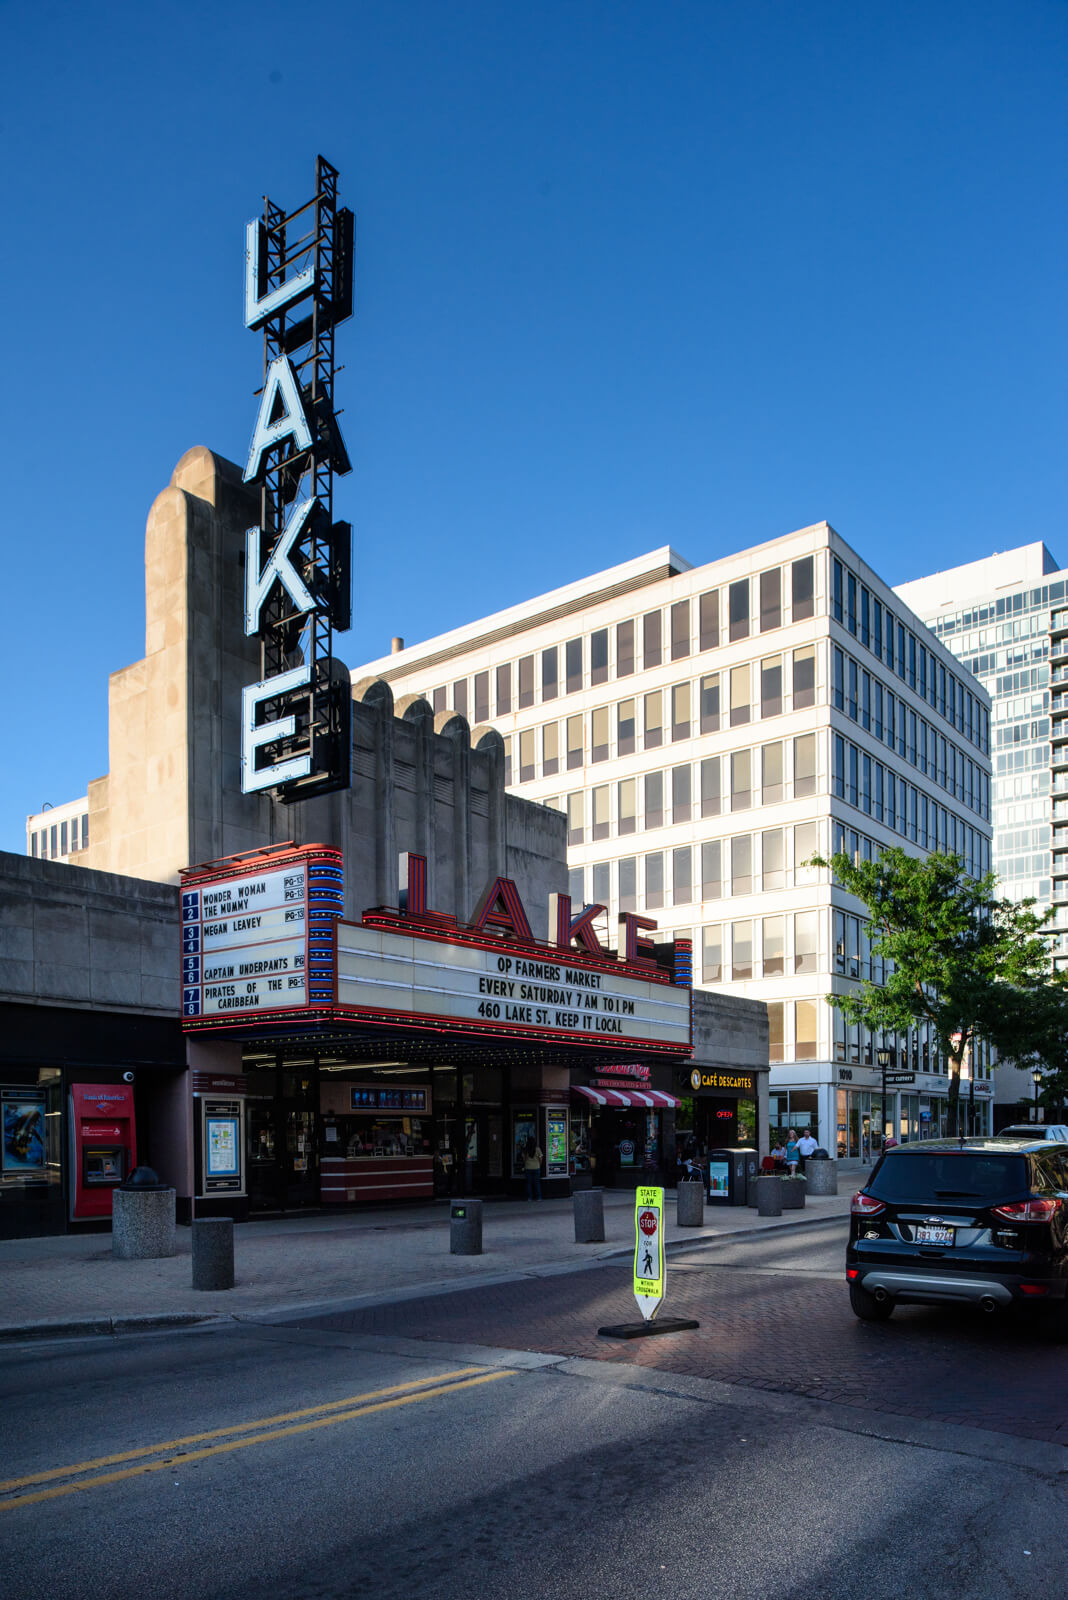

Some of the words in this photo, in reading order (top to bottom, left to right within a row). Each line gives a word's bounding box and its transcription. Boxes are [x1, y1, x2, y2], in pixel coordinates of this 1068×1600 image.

[242, 217, 318, 794] LAKE
[203, 891, 232, 905] WONDER
[238, 882, 266, 898] WOMAN
[285, 875, 304, 887] PG-13
[204, 905, 218, 918] THE
[220, 899, 249, 914] MUMMY
[285, 887, 304, 899] PG-13
[204, 923, 228, 937] MEGAN
[233, 916, 262, 932] LEAVEY
[286, 909, 304, 921] PG-13
[400, 852, 657, 970] LAKE
[204, 966, 234, 980] CAPTAIN
[239, 958, 288, 975] UNDERPANTS
[497, 957, 512, 973] OP
[516, 960, 560, 981] FARMERS
[566, 970, 601, 988] MARKET
[205, 985, 235, 998] PIRATES
[247, 983, 257, 996] OF
[268, 979, 282, 991] THE
[479, 978, 515, 997] EVERY
[521, 984, 572, 1006] SATURDAY
[576, 994, 582, 1007] 7
[585, 995, 598, 1009] AM
[603, 997, 614, 1011] TO
[623, 1000, 635, 1015] PM
[218, 995, 259, 1009] CARIBBEAN
[478, 1002, 500, 1019] 460
[506, 1005, 532, 1023] LAKE
[536, 1009, 551, 1025] ST.
[556, 1012, 579, 1028] KEEP
[583, 1015, 592, 1029] IT
[596, 1017, 623, 1033] LOCAL
[702, 1073, 717, 1086] CAFÉ
[719, 1076, 752, 1088] DESCARTES
[839, 1069, 853, 1080] 1010
[716, 1111, 733, 1119] OPEN
[640, 1189, 657, 1197] STATE
[640, 1219, 657, 1228] STOP
